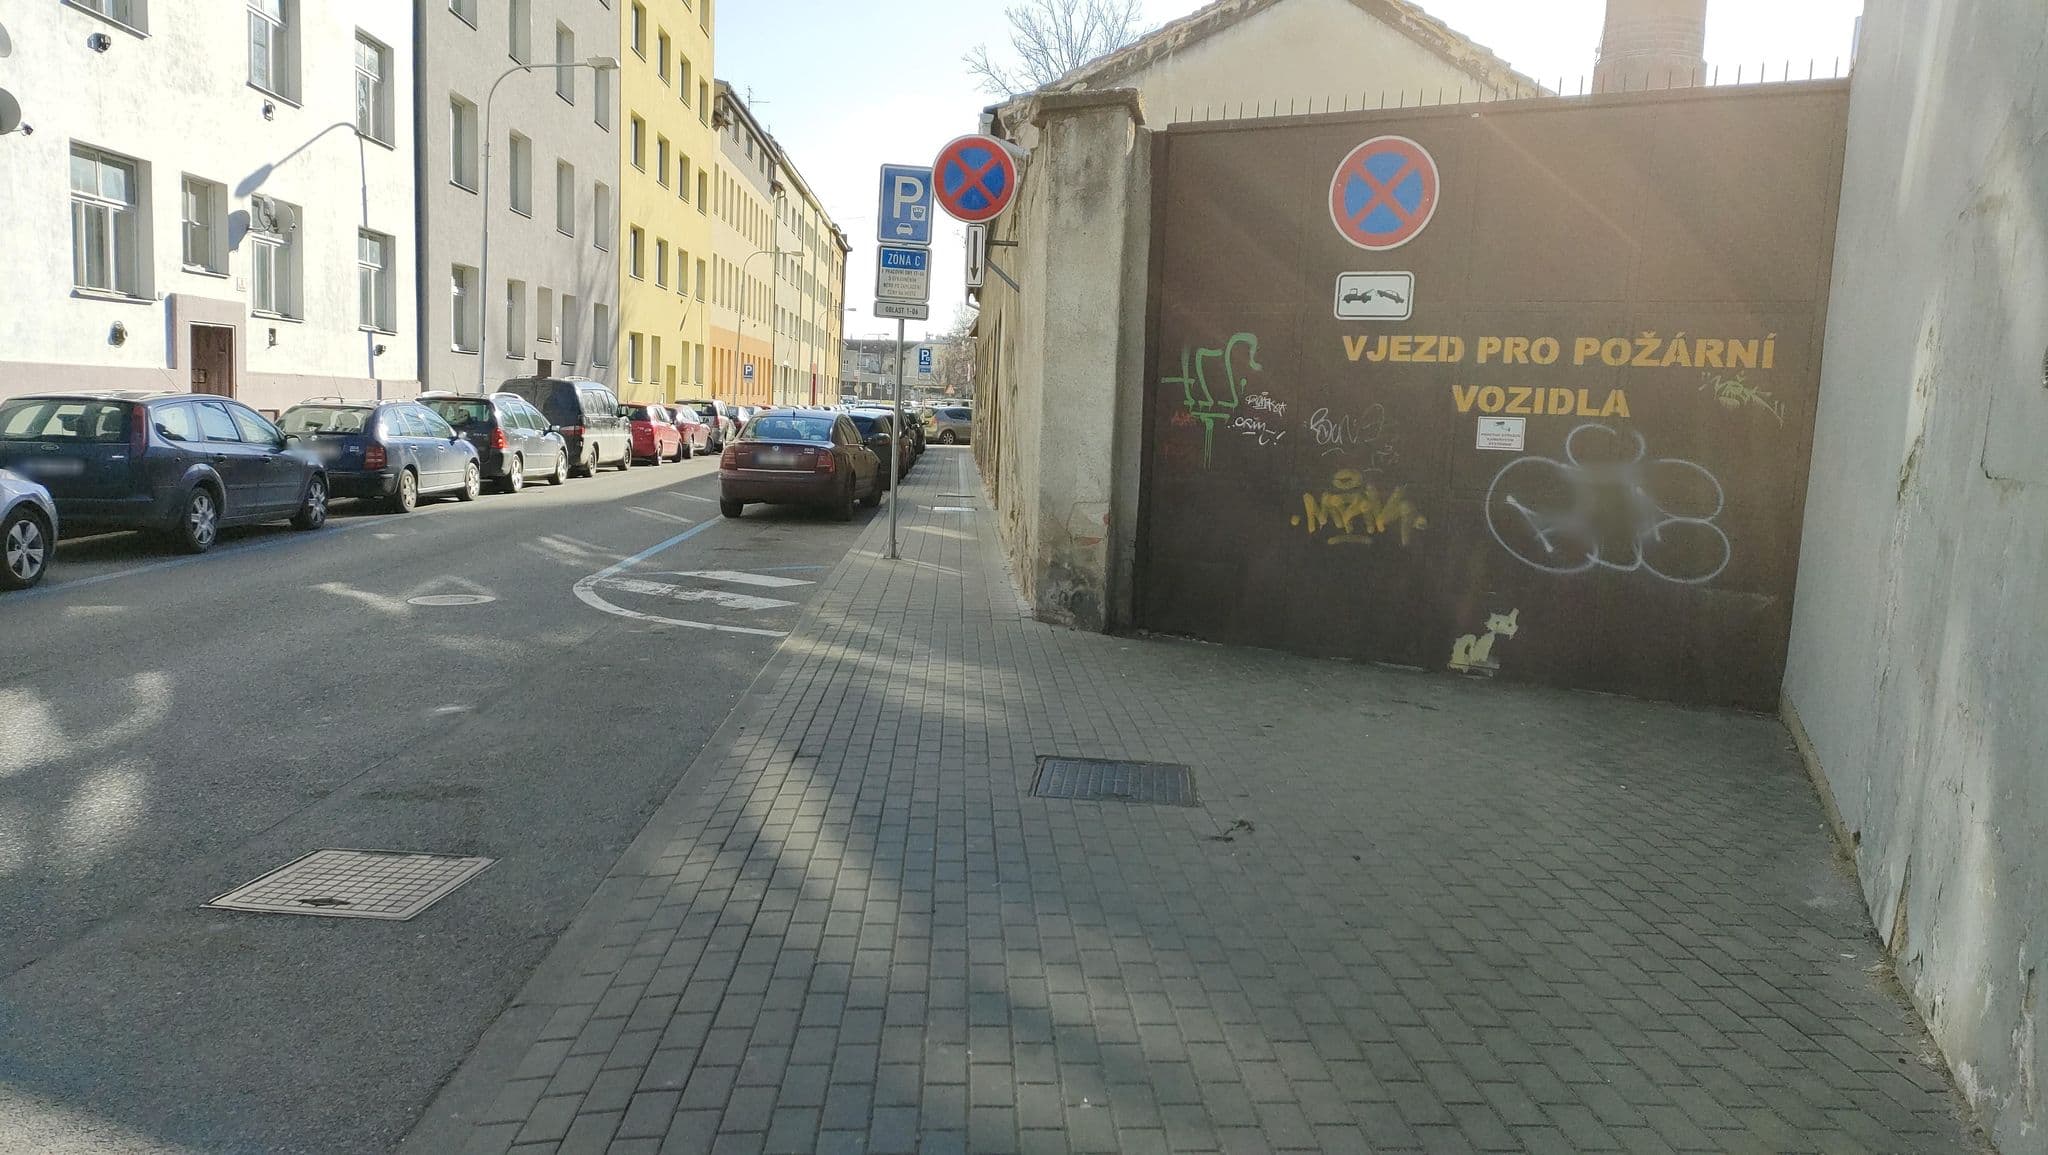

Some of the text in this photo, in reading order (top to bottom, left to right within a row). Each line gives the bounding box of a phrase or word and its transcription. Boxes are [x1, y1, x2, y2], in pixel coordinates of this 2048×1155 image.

[893, 176, 924, 218] P
[915, 255, 921, 267] C
[1343, 331, 1778, 369] VJEZD PRO POŽÁRNÍ
[1451, 384, 1632, 417] VOZIDLA
